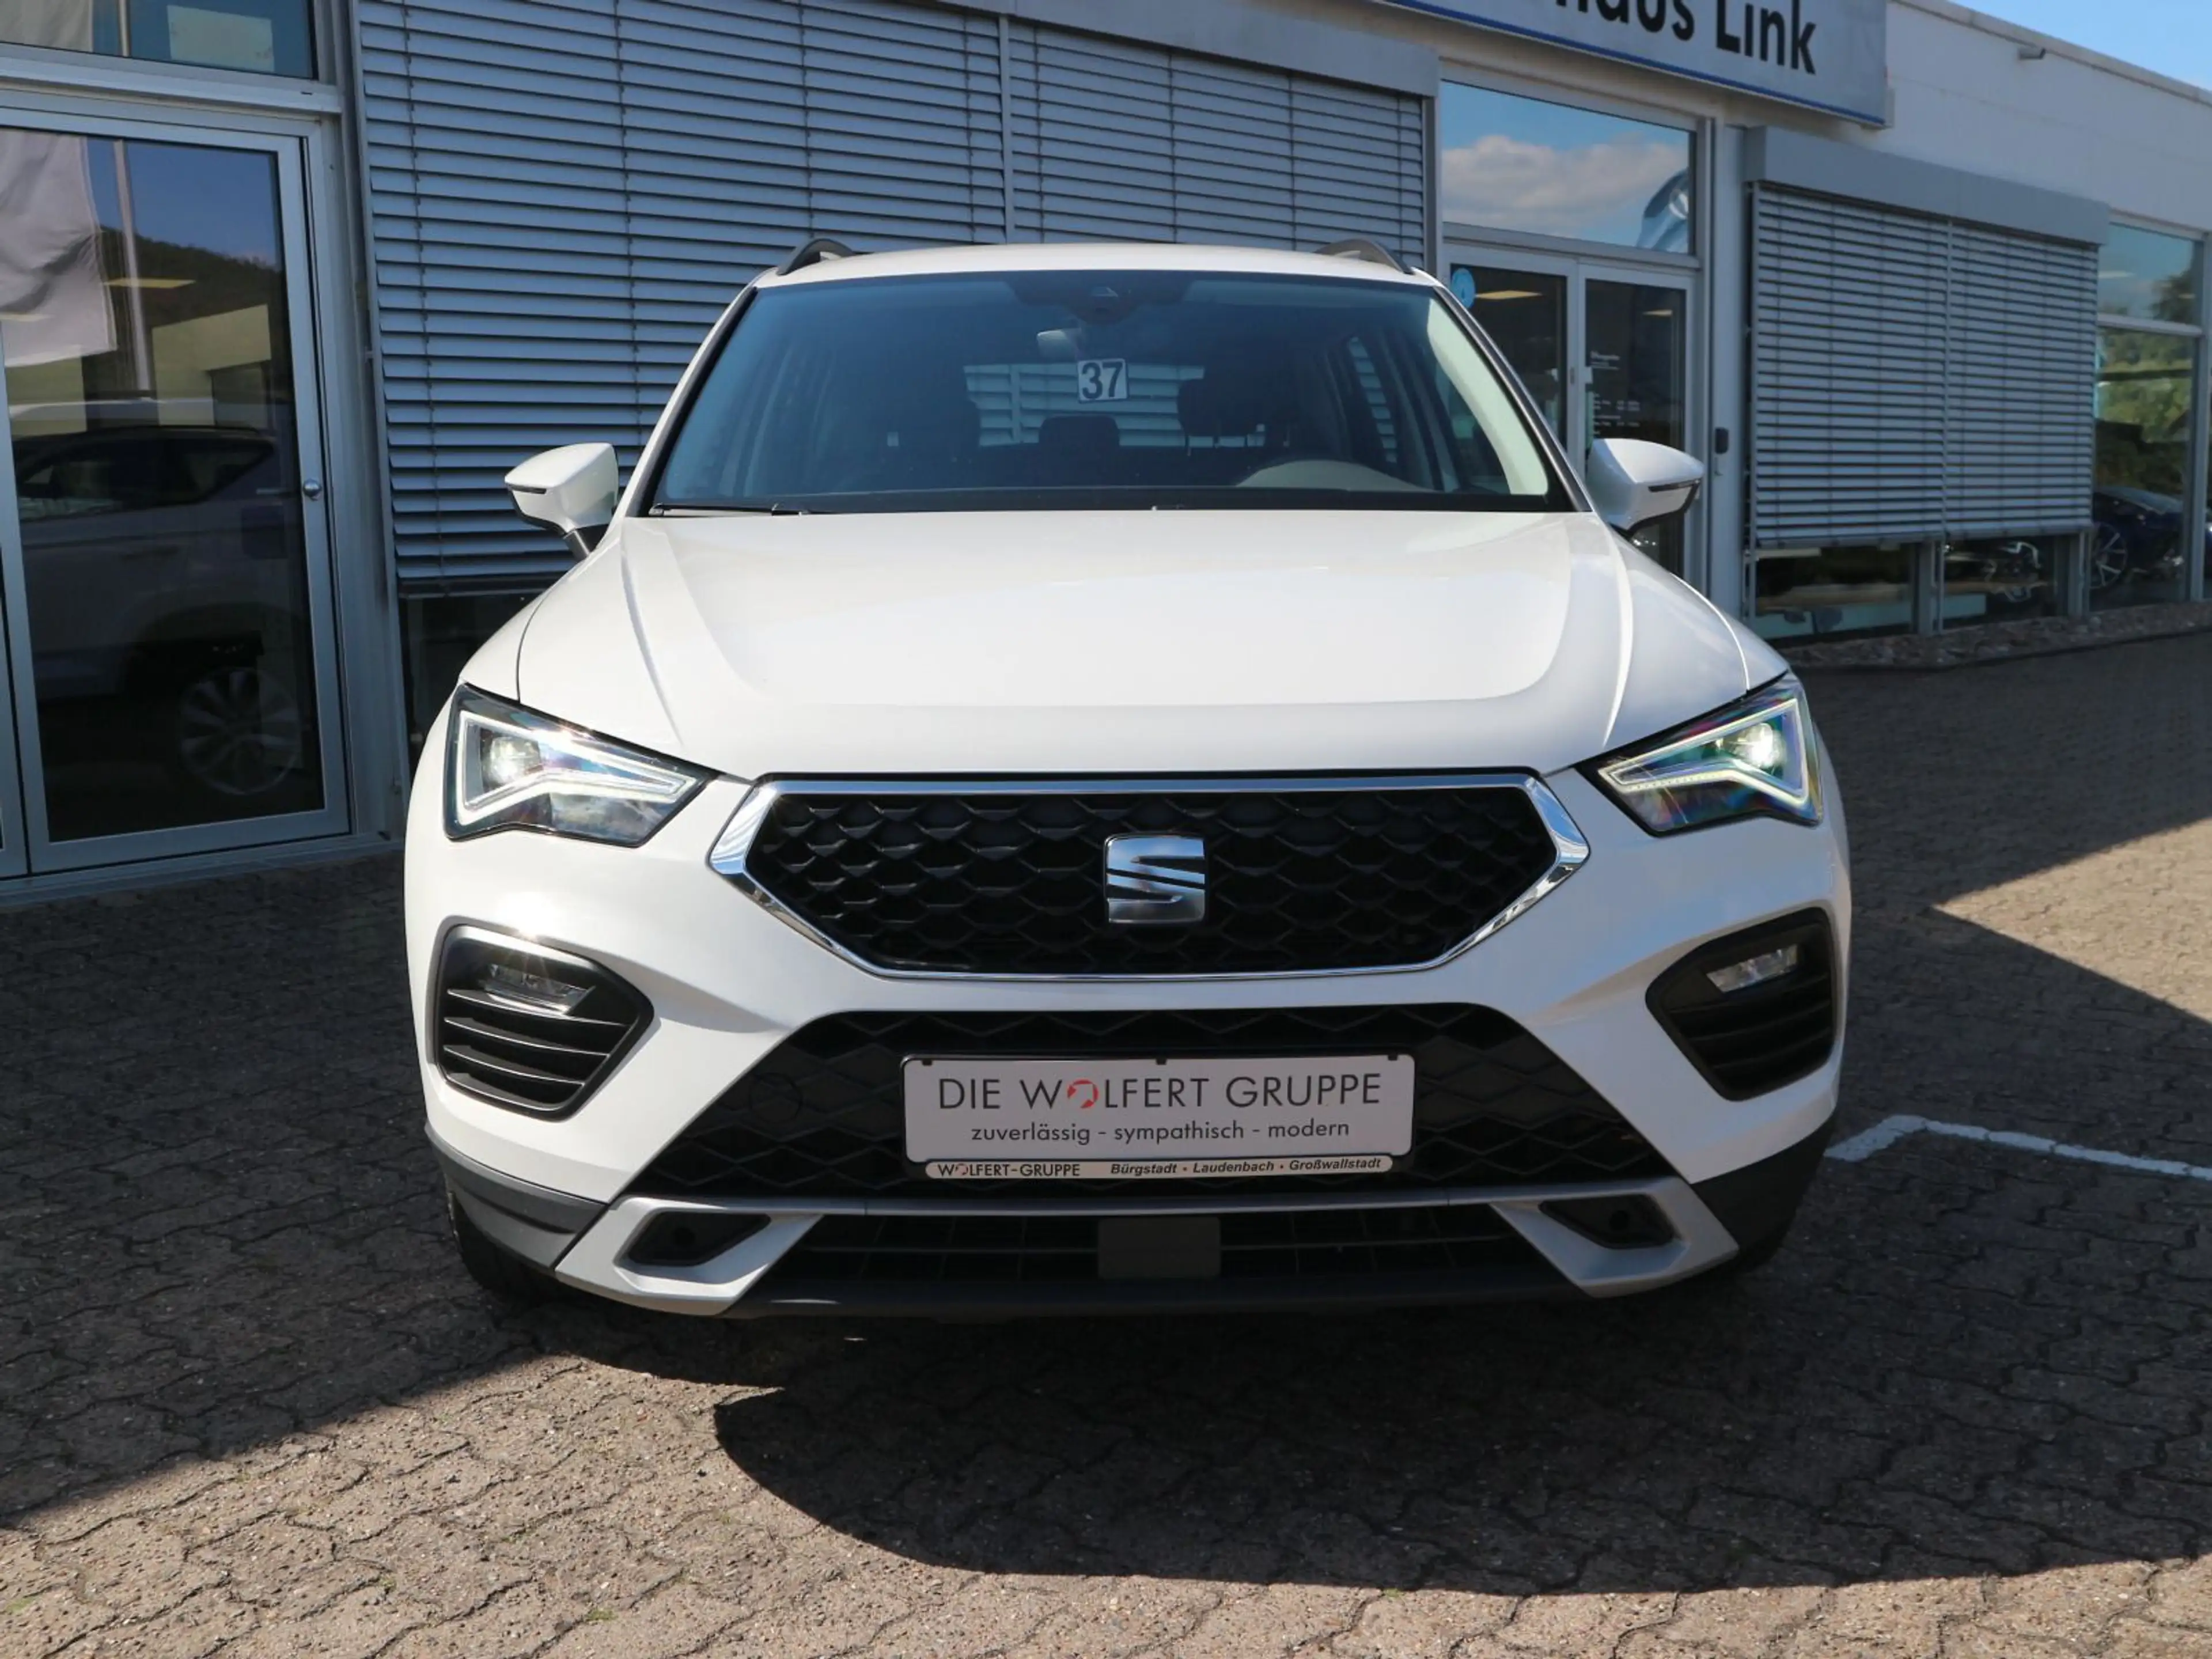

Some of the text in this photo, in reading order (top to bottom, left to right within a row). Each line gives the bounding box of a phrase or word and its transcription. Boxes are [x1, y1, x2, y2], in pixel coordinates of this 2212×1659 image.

[1555, 0, 1816, 75] us Link
[1082, 362, 1123, 400] 37
[938, 1078, 1001, 1109] DIE
[1225, 1073, 1381, 1108] GRUPPE
[971, 1122, 1091, 1146] zuverlässig
[1114, 1120, 1244, 1145] sympathisch
[1267, 1118, 1350, 1138] modern
[1110, 1162, 1177, 1175] Bürgstadt
[1192, 1161, 1275, 1174] Laudenbach
[1289, 1158, 1381, 1172] Großwallstadt
